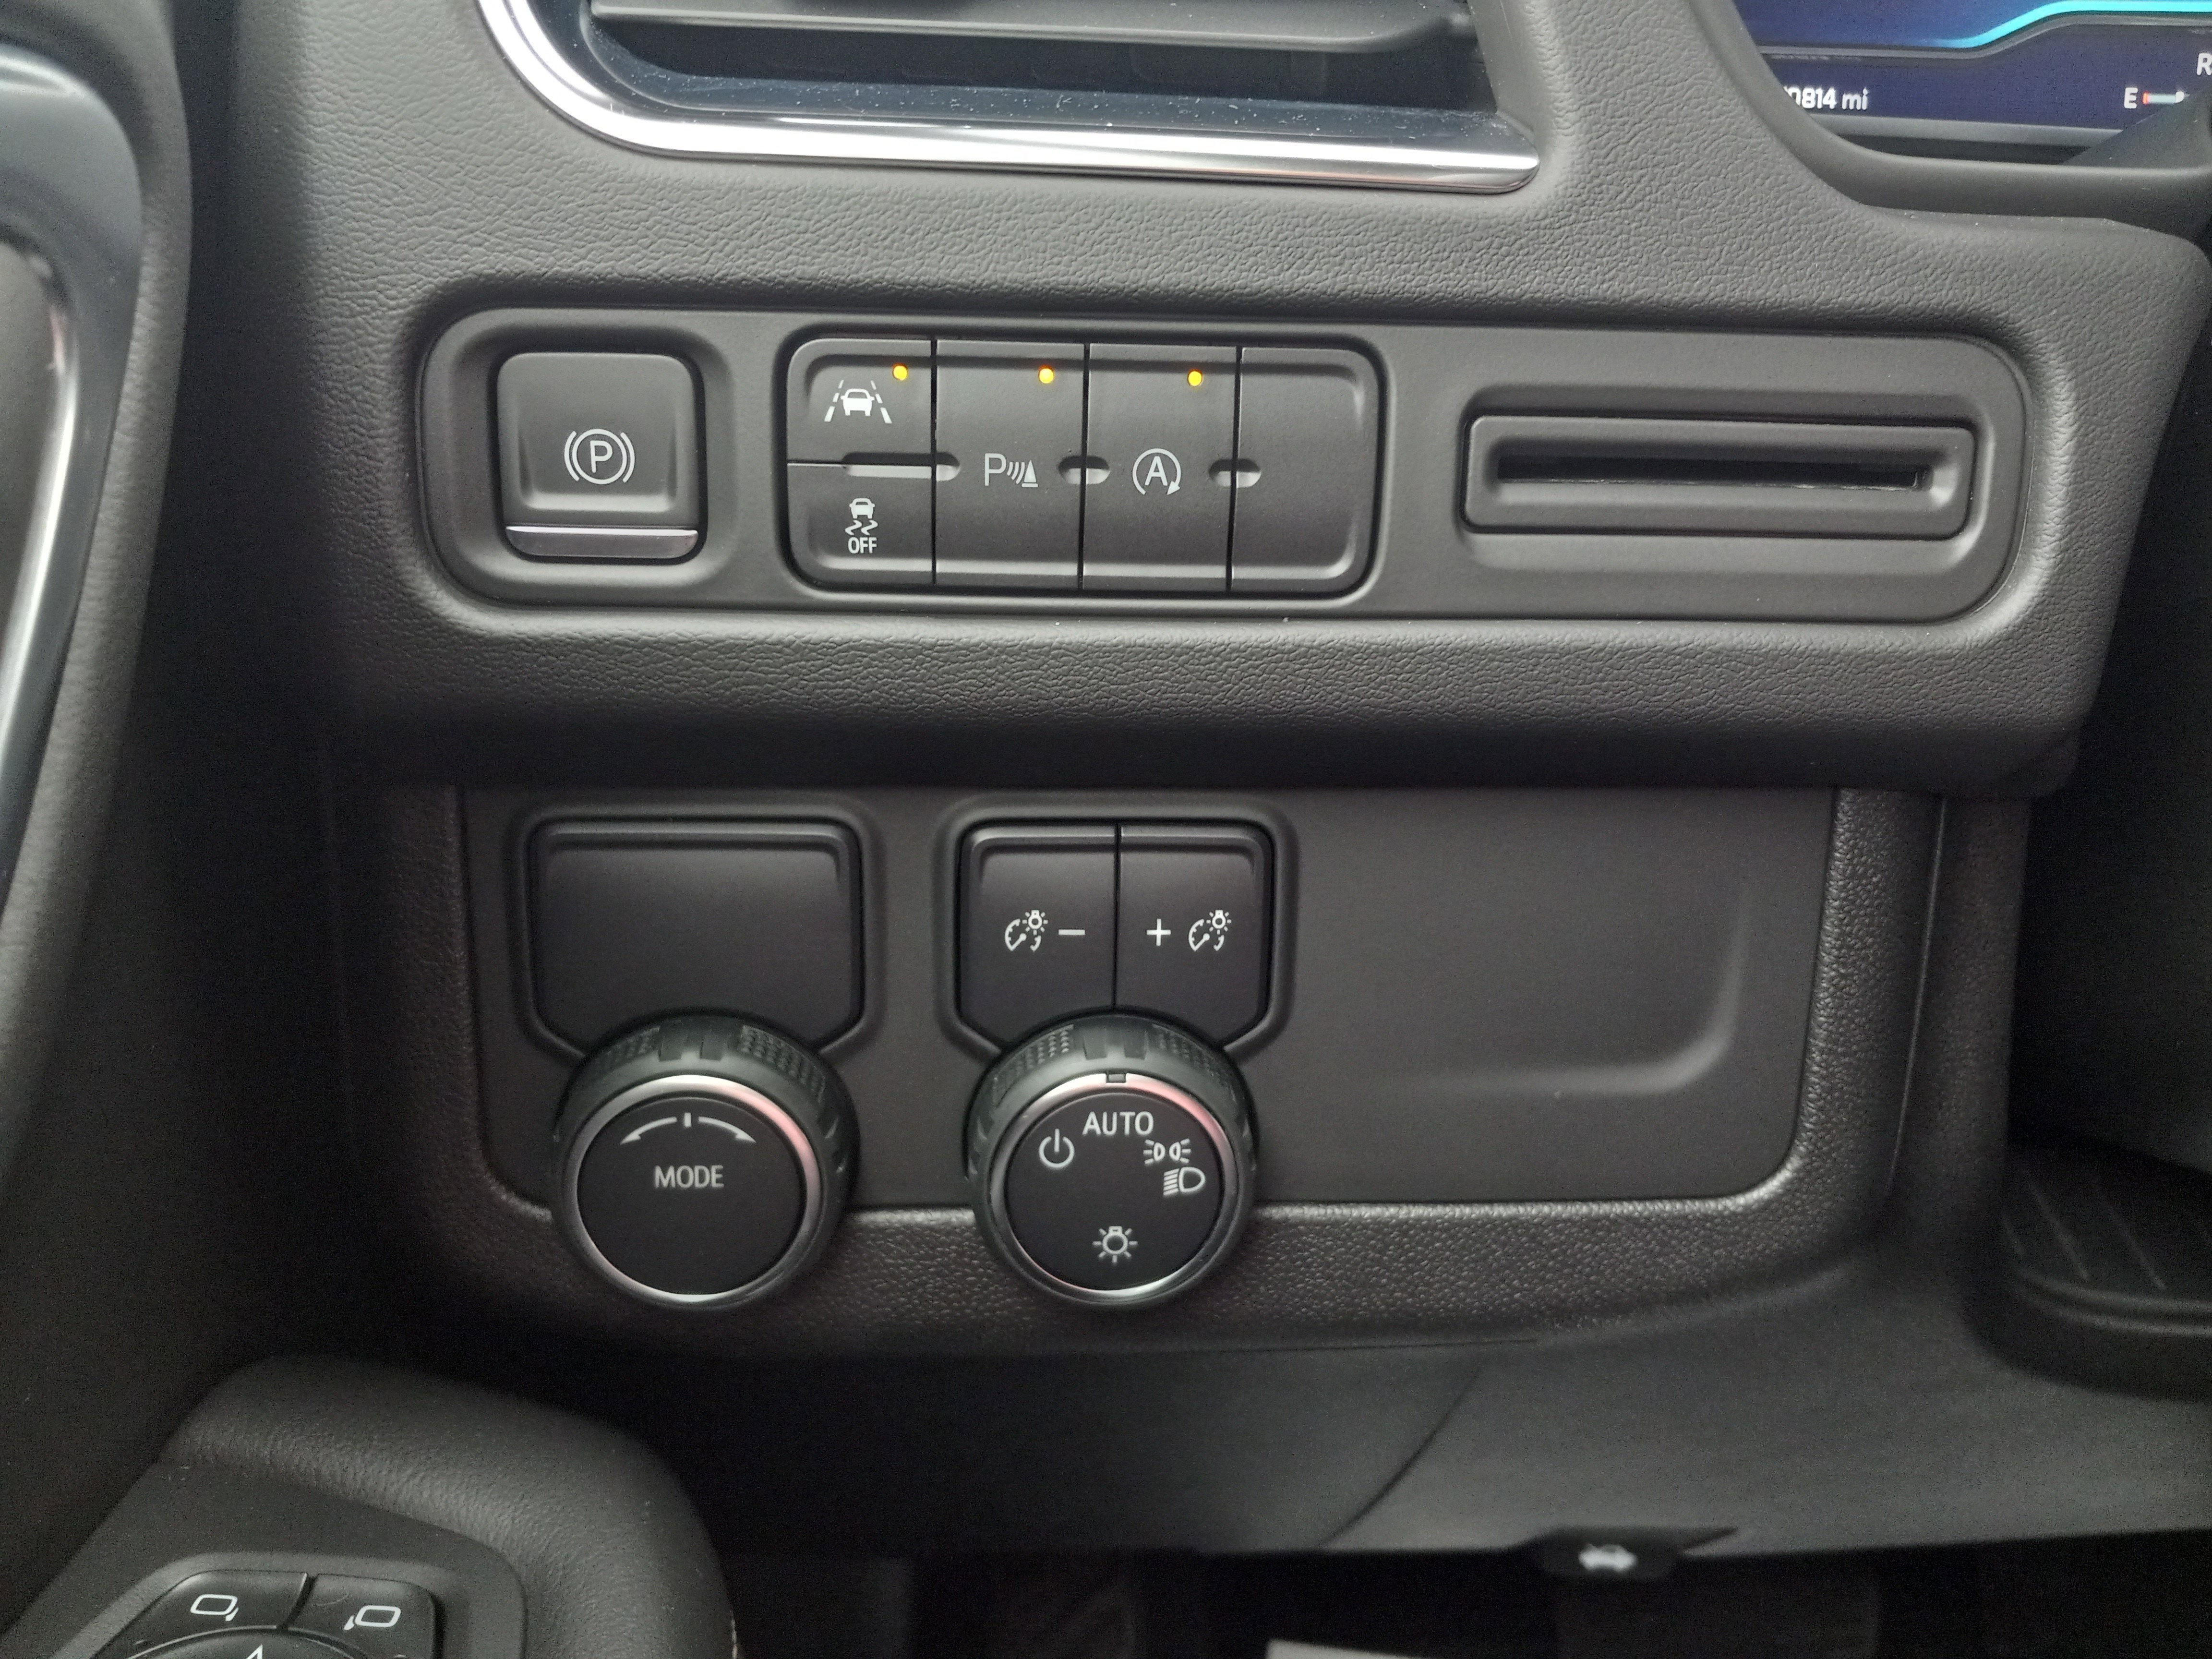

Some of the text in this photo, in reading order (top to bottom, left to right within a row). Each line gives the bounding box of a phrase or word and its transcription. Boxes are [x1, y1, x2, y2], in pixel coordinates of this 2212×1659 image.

[2197, 53, 2212, 75] R
[1783, 86, 1868, 110] 0814 mi
[2124, 87, 2138, 108] E
[590, 440, 613, 473] P
[848, 537, 877, 553] OFF
[1082, 1111, 1154, 1136] AUTO
[654, 1165, 725, 1188] MODE
